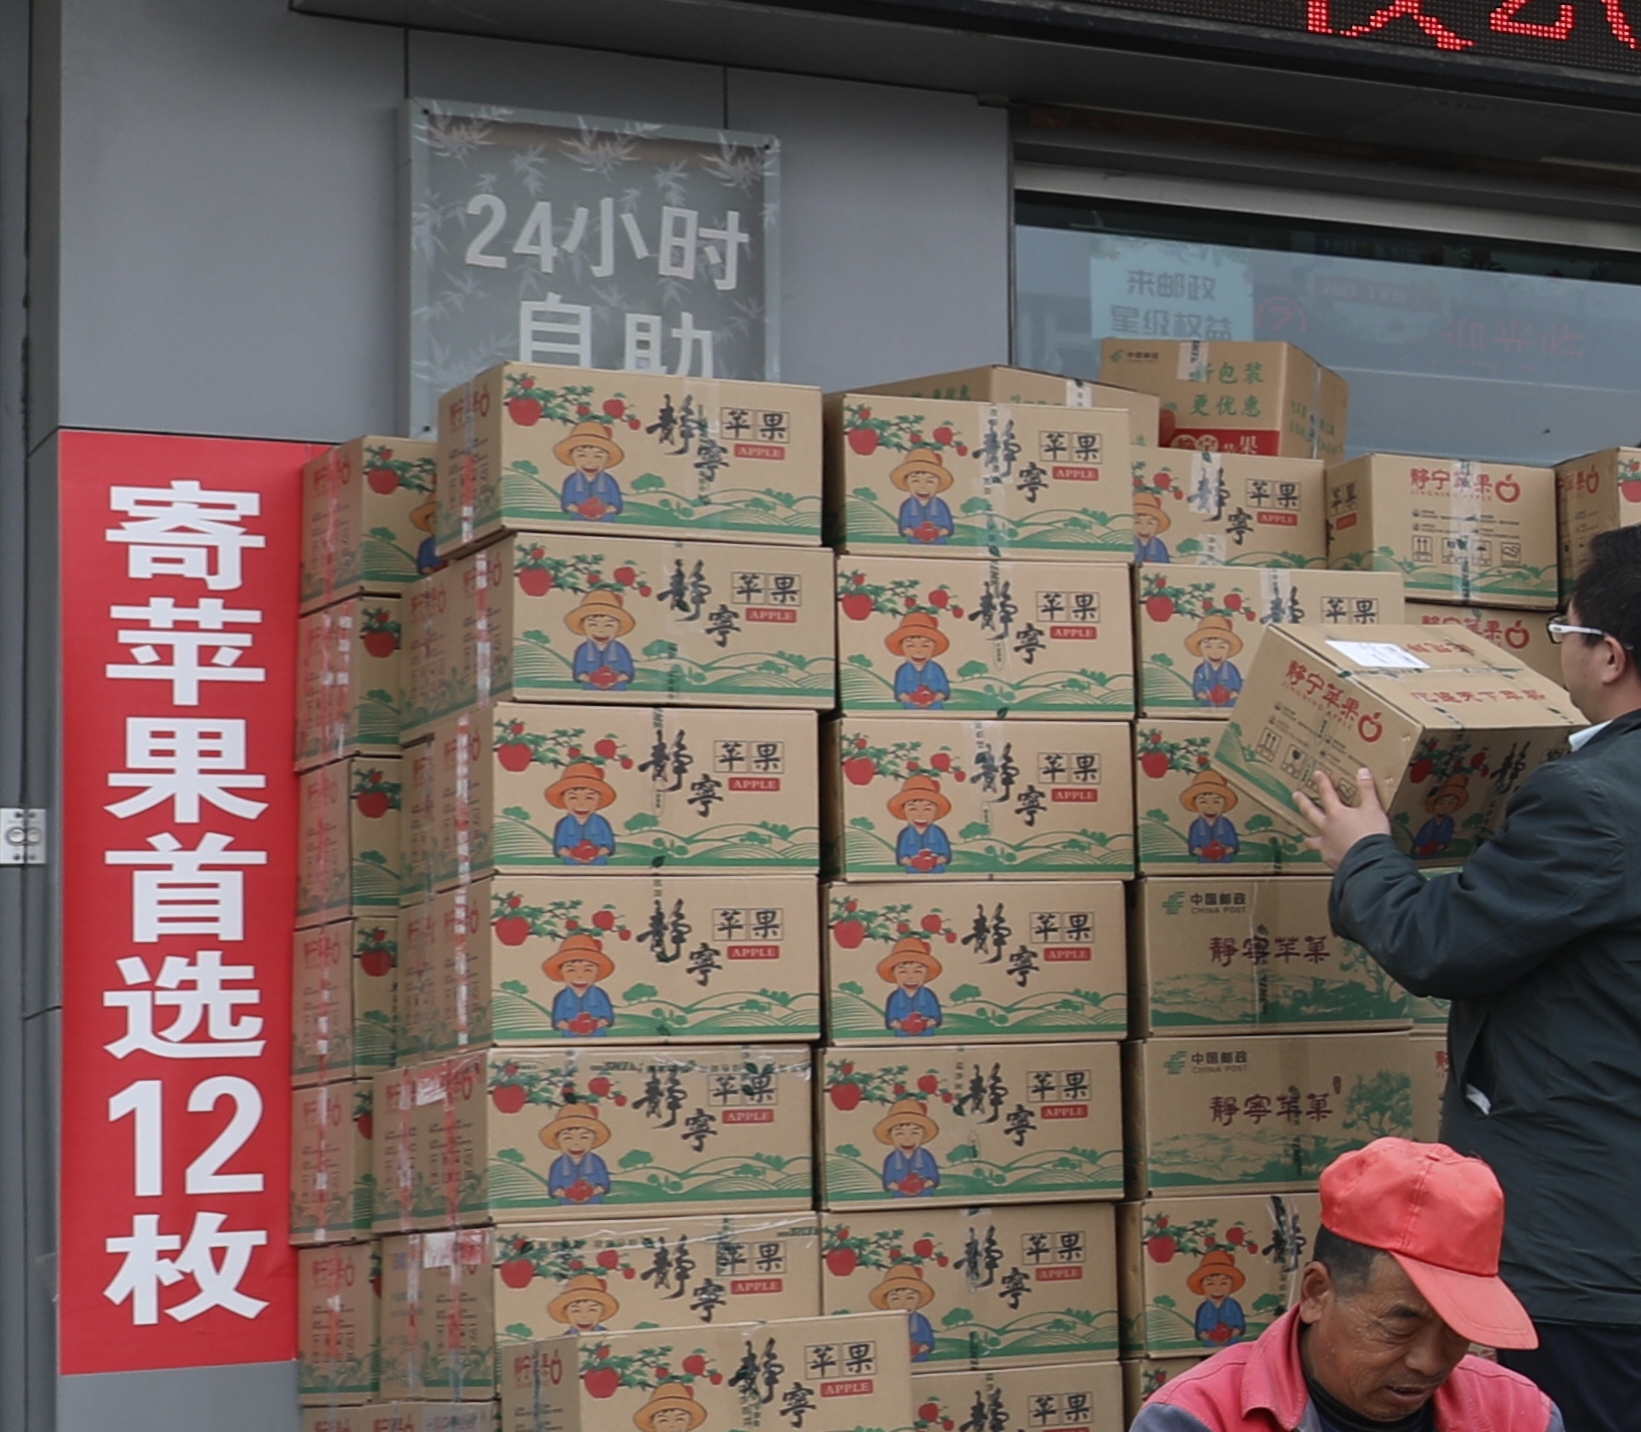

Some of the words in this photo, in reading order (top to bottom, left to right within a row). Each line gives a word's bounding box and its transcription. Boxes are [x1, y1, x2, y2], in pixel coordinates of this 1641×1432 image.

[464, 194, 749, 292] 24小时
[1189, 395, 1264, 418] 更优惠
[1284, 658, 1361, 718] 静宁苹果
[720, 743, 779, 770] 苹果
[733, 780, 776, 789] APPLE
[1190, 891, 1247, 906] 中国邮政
[719, 911, 778, 937] 苹果
[732, 948, 775, 958] APPLE
[1191, 1050, 1248, 1064] 中国邮政
[812, 1344, 872, 1374] 苹果
[825, 1382, 868, 1394] APPLE
